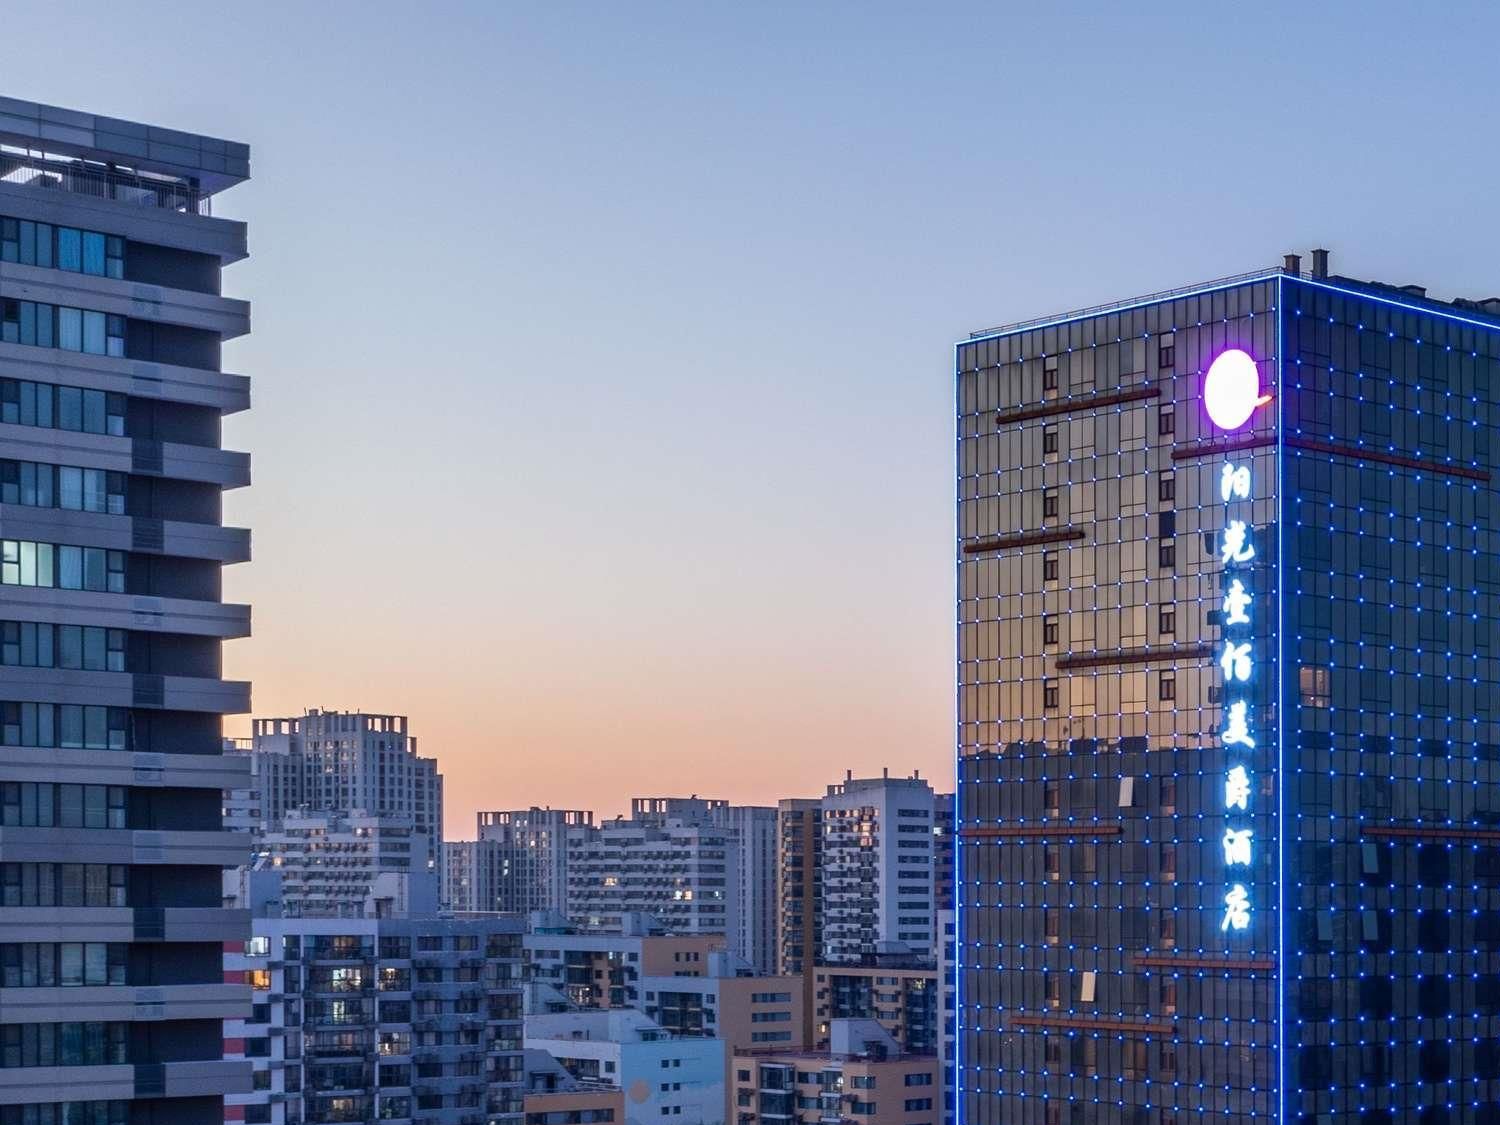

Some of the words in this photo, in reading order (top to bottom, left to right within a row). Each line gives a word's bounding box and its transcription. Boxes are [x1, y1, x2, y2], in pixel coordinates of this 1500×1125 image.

[1221, 464, 1256, 932] 阳光壹佰美爵酒店
